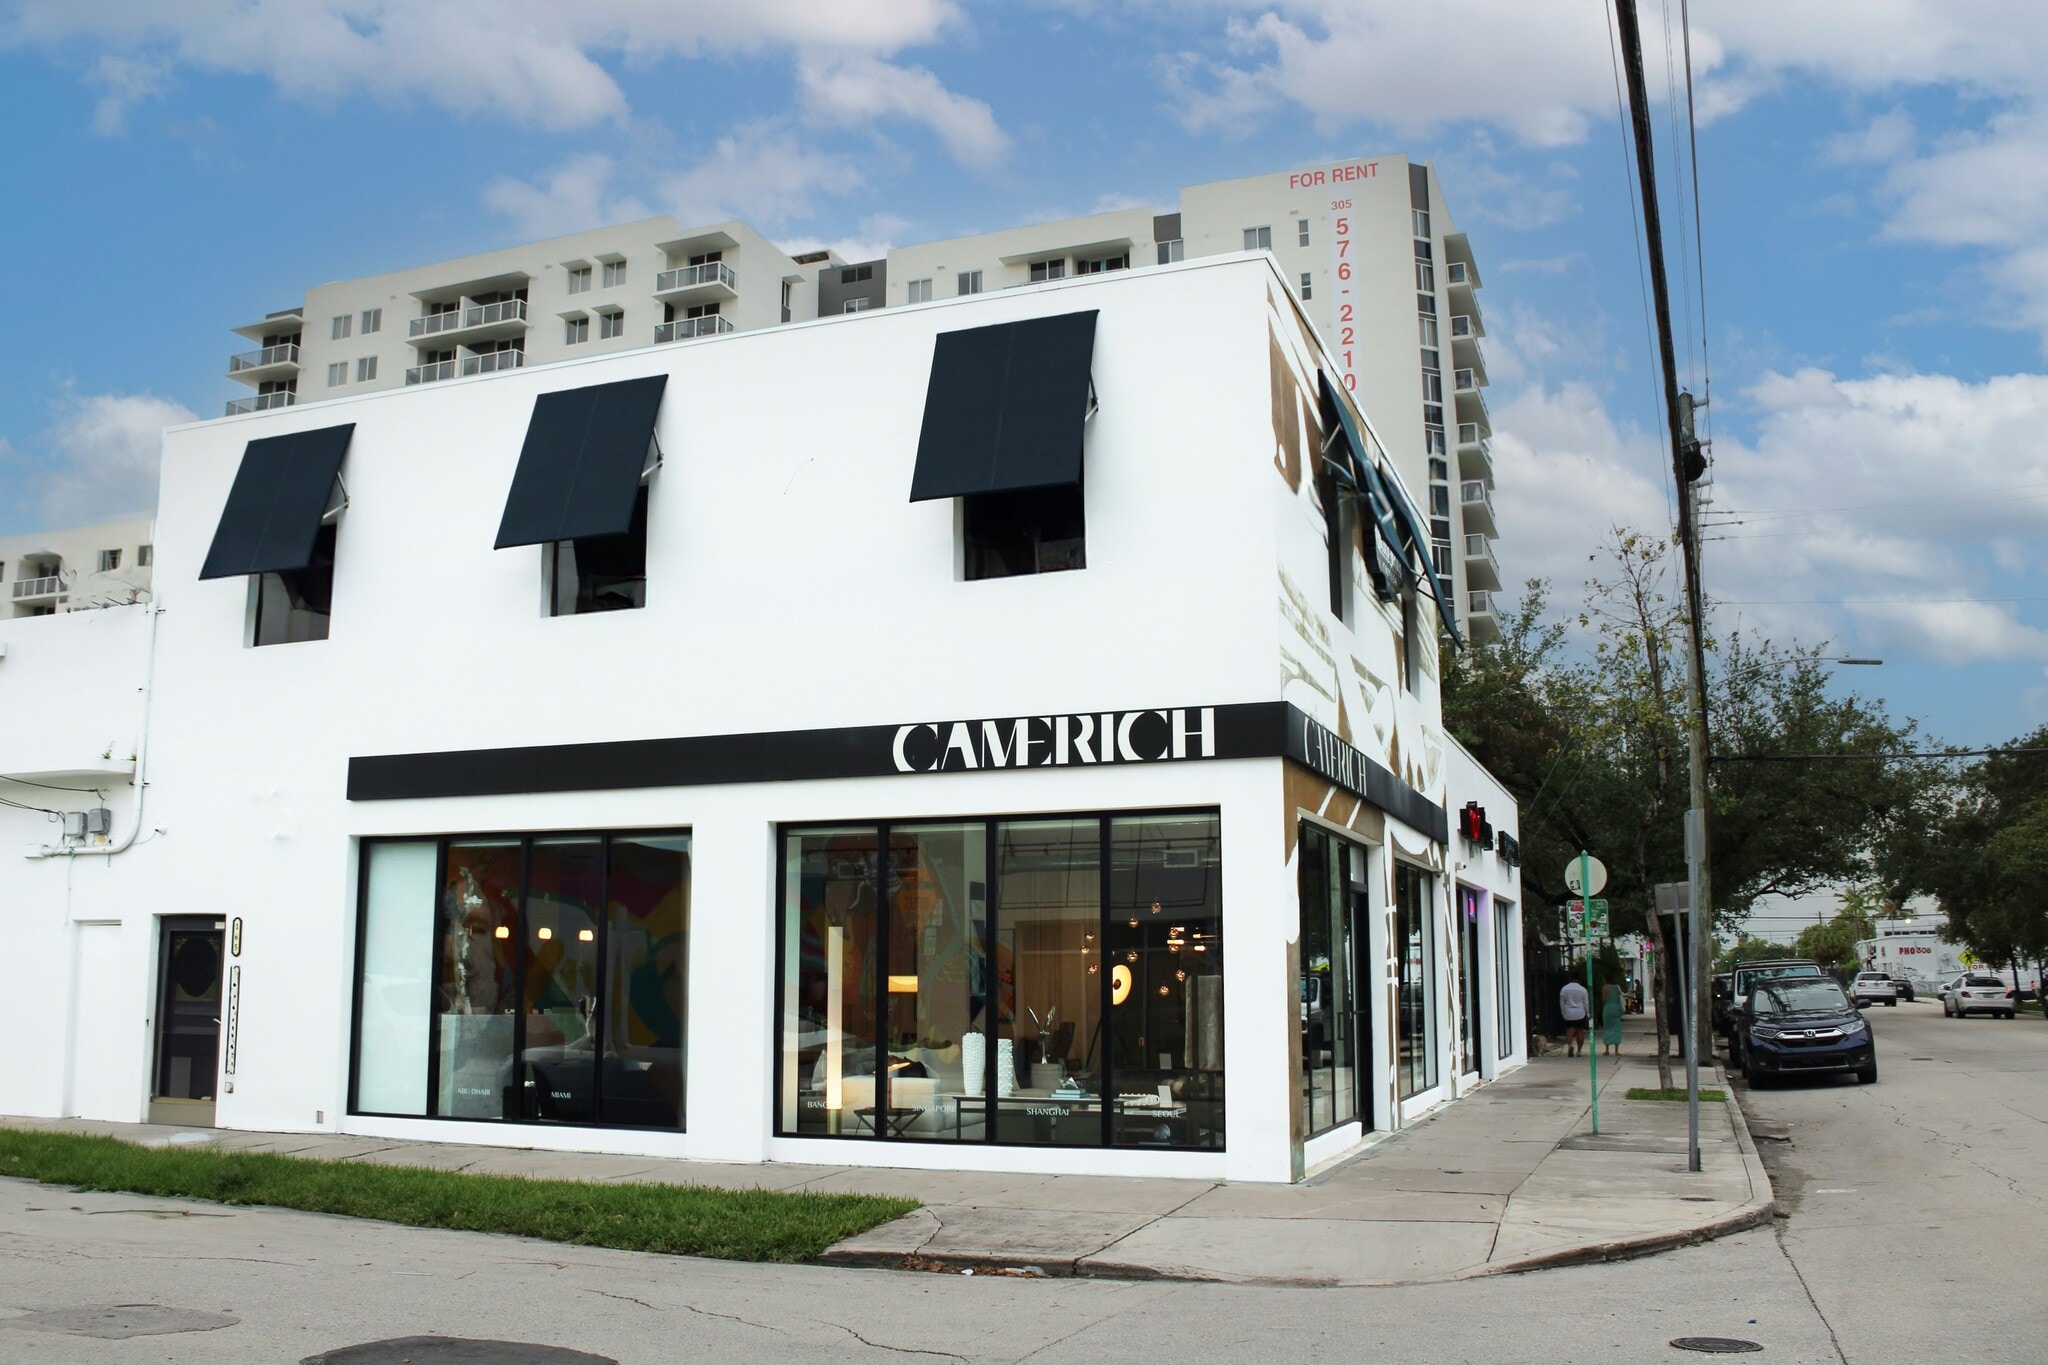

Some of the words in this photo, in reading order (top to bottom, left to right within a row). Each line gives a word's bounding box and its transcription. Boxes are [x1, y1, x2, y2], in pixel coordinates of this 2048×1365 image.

[1290, 171, 1326, 190] FOR
[1332, 163, 1379, 184] RENT
[1331, 199, 1352, 211] 305
[1336, 217, 1357, 392] 576-2210
[892, 707, 1216, 773] CAMERICH
[458, 1087, 469, 1095] ABU
[471, 1088, 491, 1096] DHABI
[551, 1091, 572, 1099] MIAMI
[1026, 1107, 1070, 1117] SHANGHAI
[1152, 1109, 1181, 1118] SEOUL
